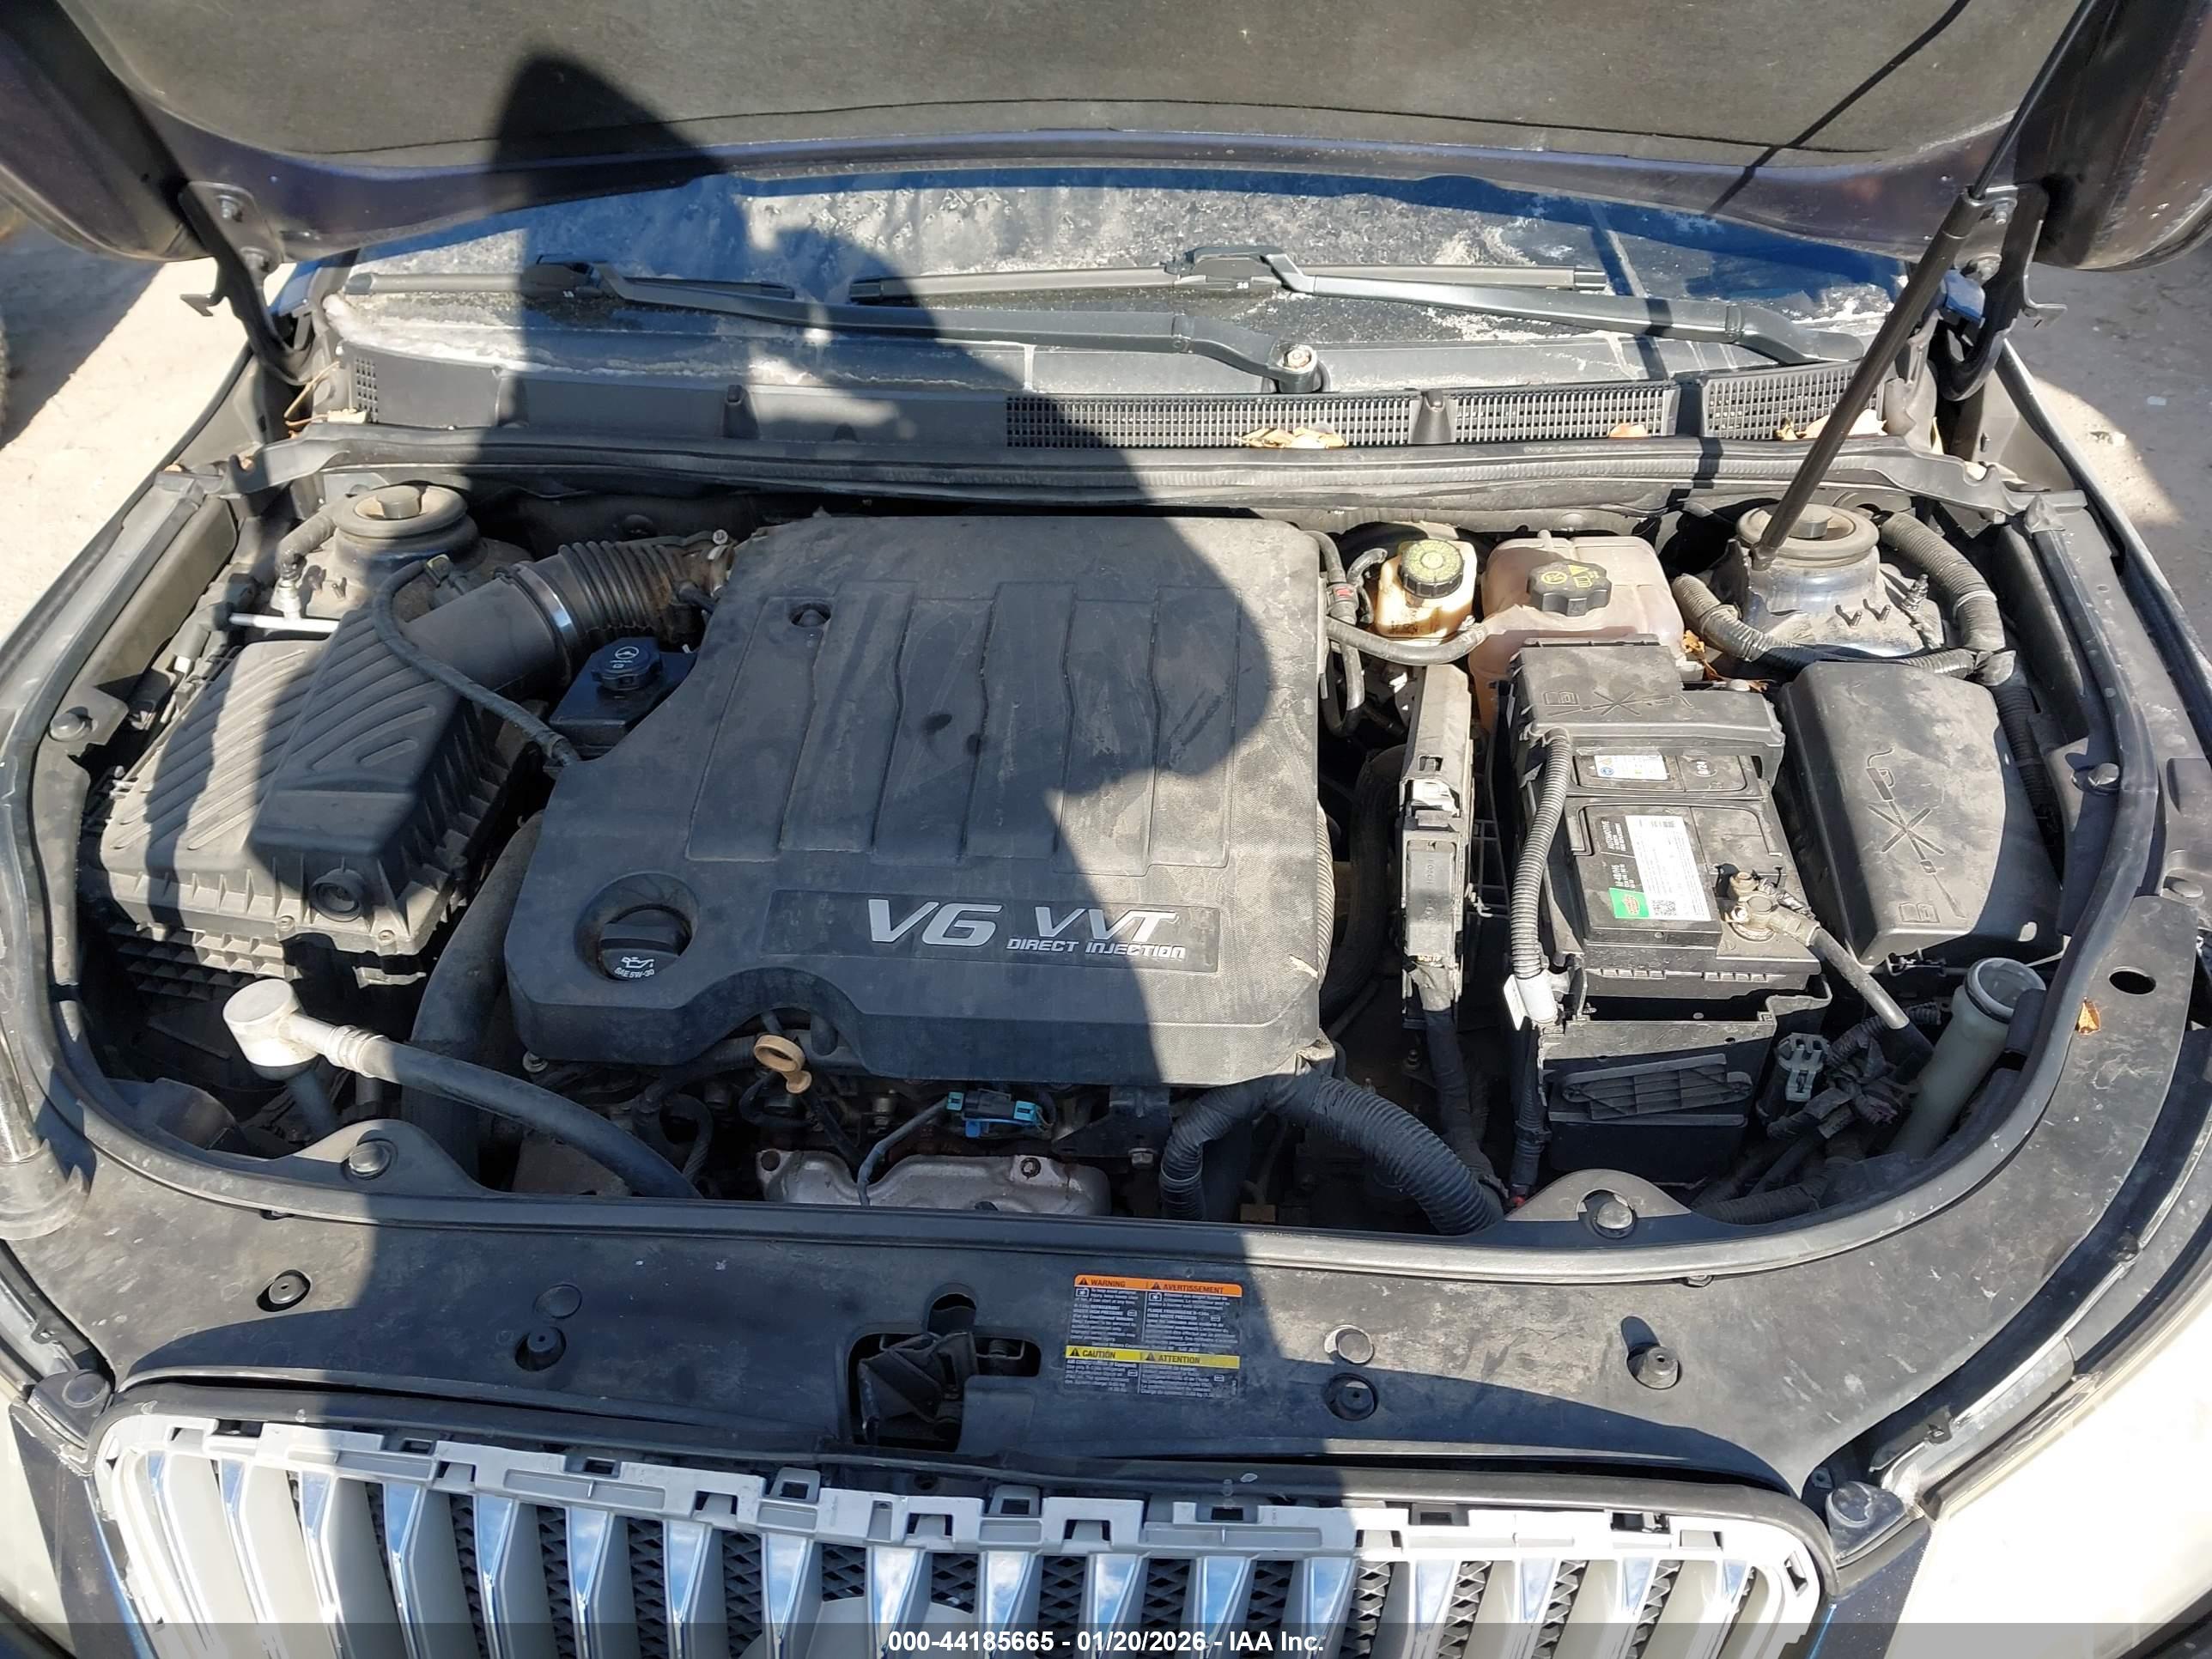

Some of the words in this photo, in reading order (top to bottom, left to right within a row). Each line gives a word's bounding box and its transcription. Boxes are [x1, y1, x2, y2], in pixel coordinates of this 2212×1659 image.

[1601, 820, 1615, 850] AUTOMOTIVE
[867, 899, 1003, 947] V6
[1034, 906, 1179, 944] VVT
[1006, 938, 1079, 954] DIRECT
[1085, 941, 1186, 960] INJECTION
[614, 967, 629, 978] SAE
[629, 969, 655, 978] 5W-30
[1091, 1279, 1127, 1288] WARNING
[1163, 1283, 1224, 1294] AVERTISSEMENT
[1082, 1349, 1116, 1360] CAUTION
[1158, 1354, 1200, 1364] ATTENTION
